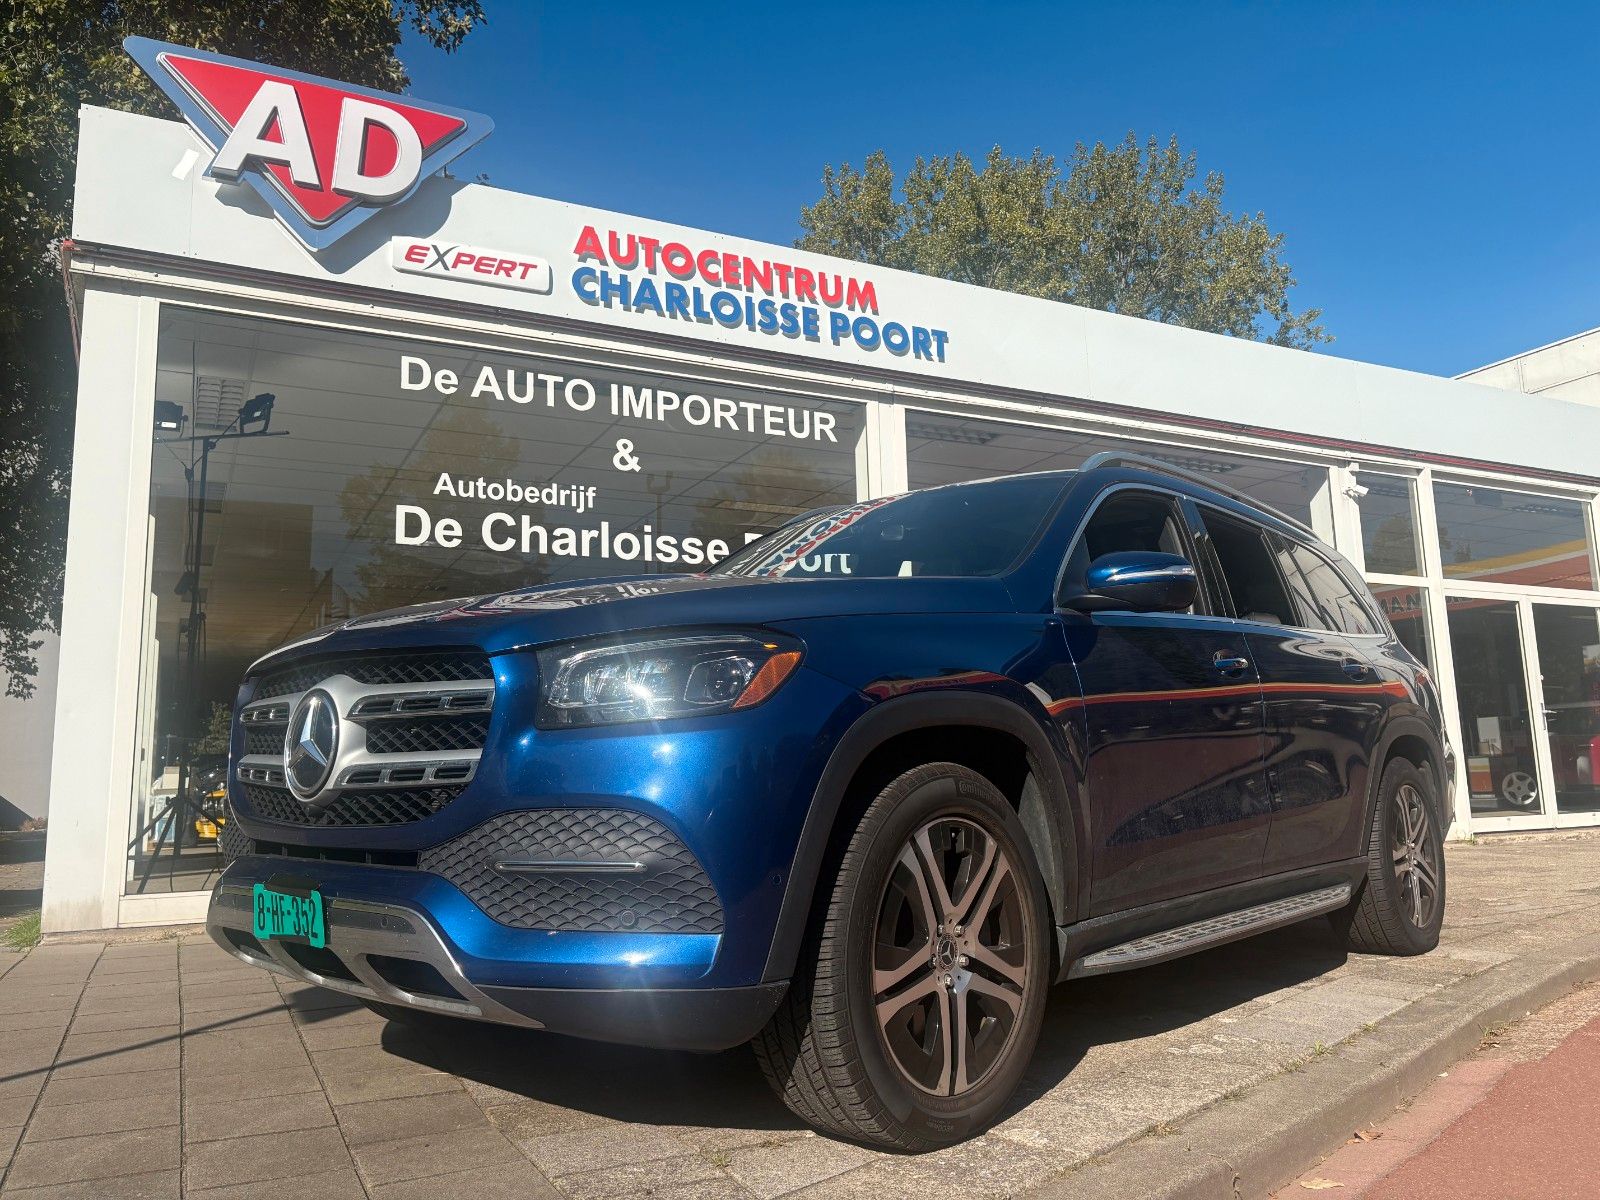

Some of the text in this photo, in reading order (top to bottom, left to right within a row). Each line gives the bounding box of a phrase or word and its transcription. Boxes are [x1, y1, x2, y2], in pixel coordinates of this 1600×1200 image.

[210, 79, 423, 201] AD
[403, 243, 538, 280] EXPERT
[573, 225, 879, 314] AUTOCENTRUM
[571, 266, 949, 363] CHARLOISSE POORT
[399, 355, 838, 443] De AUTO IMPORTEUR
[433, 472, 597, 513] Autobedrijf
[612, 438, 642, 474] &
[394, 504, 464, 549] De
[481, 511, 730, 565] Charloisse
